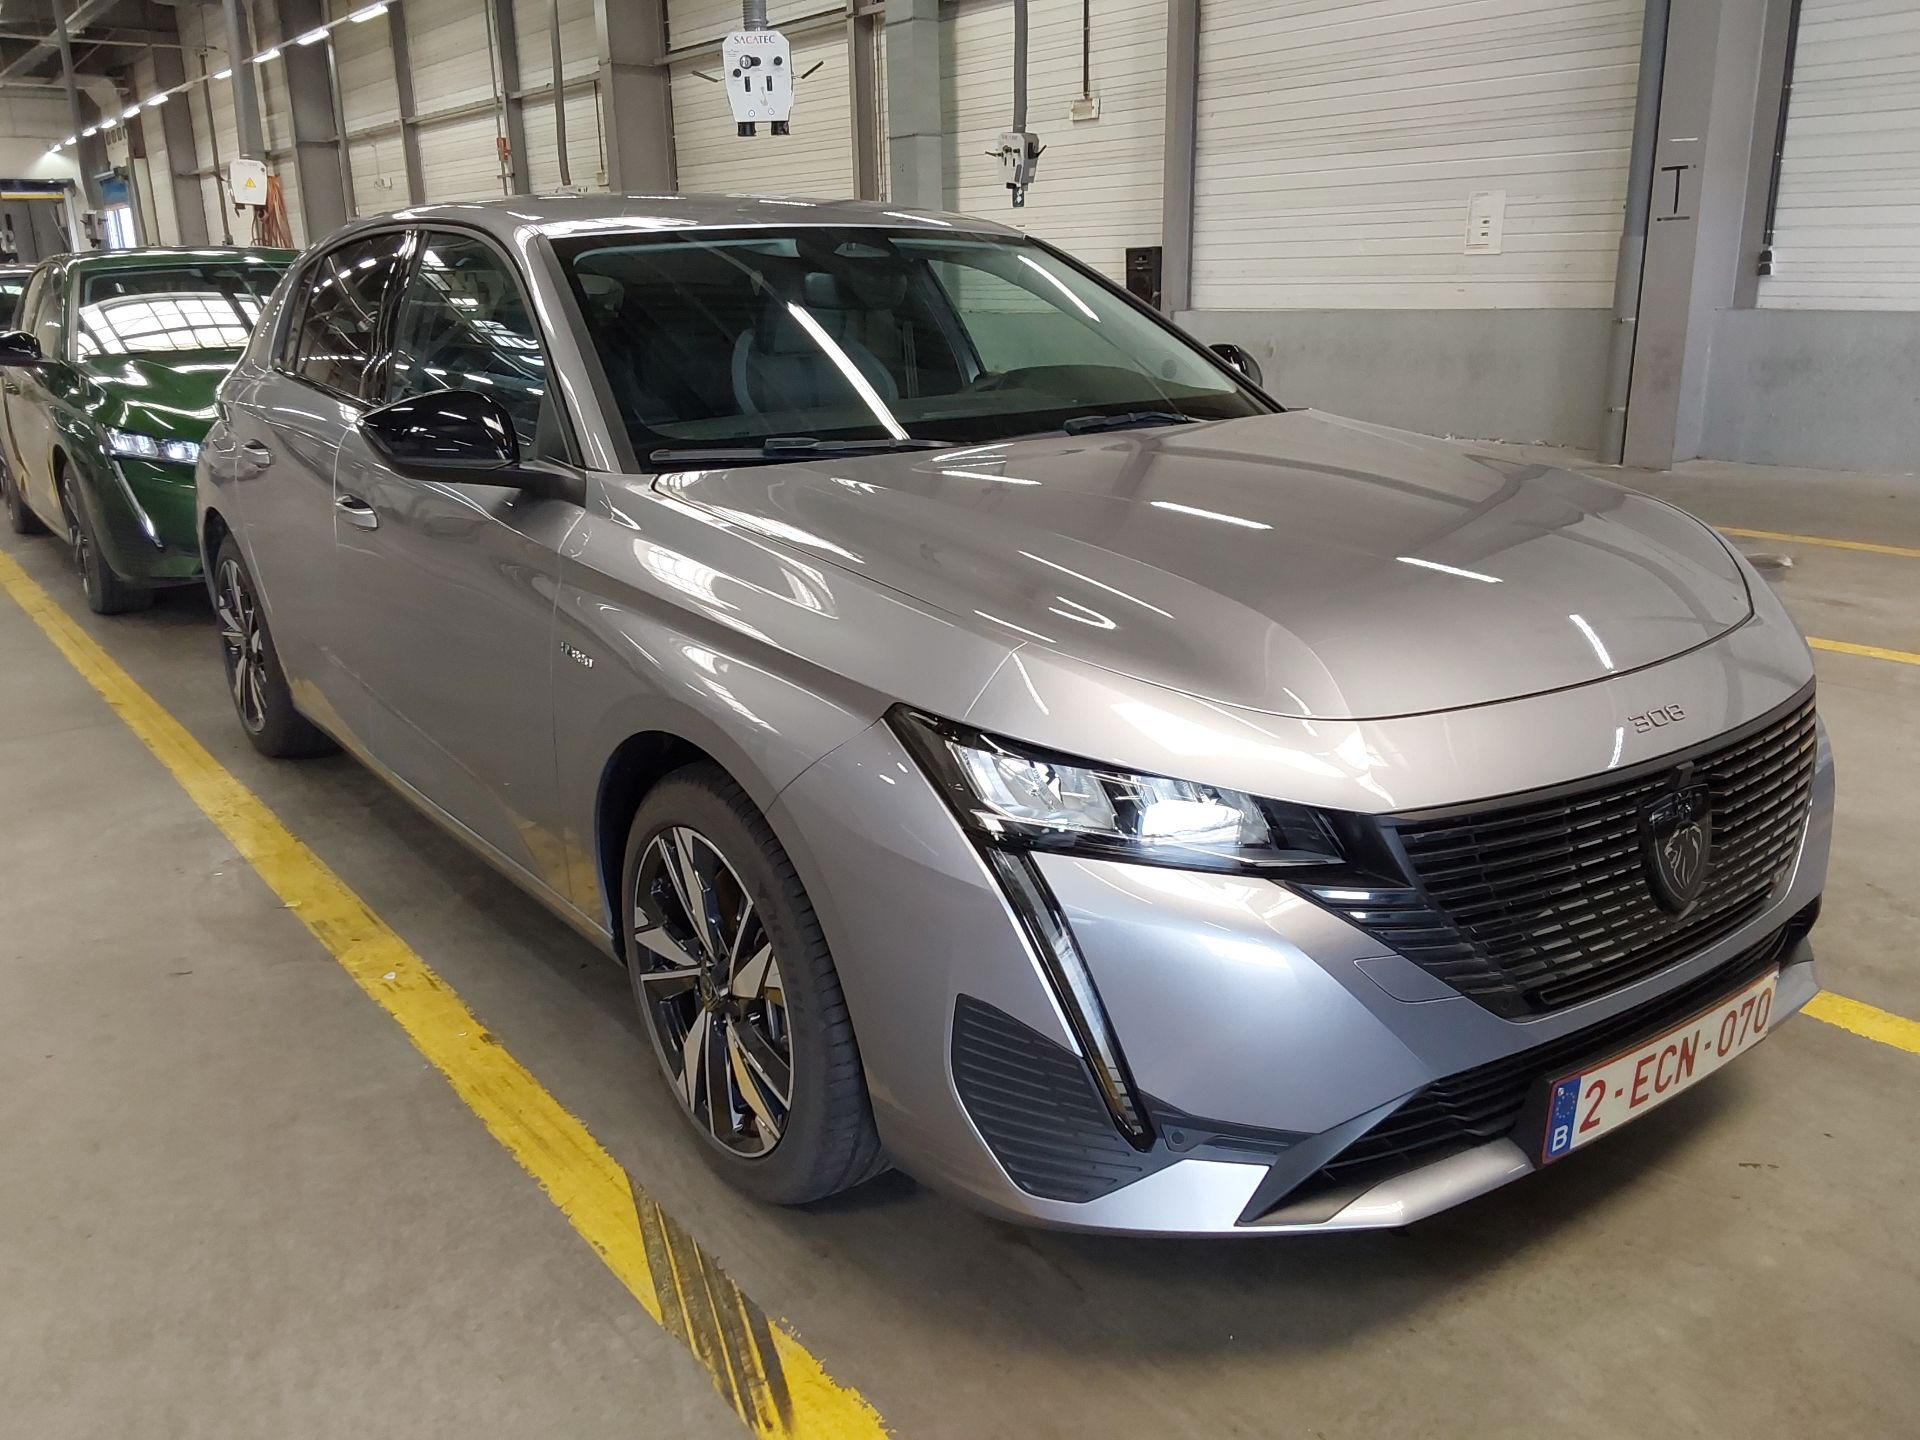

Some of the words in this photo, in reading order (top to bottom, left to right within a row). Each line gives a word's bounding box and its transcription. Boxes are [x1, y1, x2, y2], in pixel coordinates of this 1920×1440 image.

[734, 35, 776, 44] SACATEC
[1628, 703, 1686, 733] 308
[1579, 987, 1772, 1133] 2-ECN-070
[1551, 1125, 1568, 1152] B
